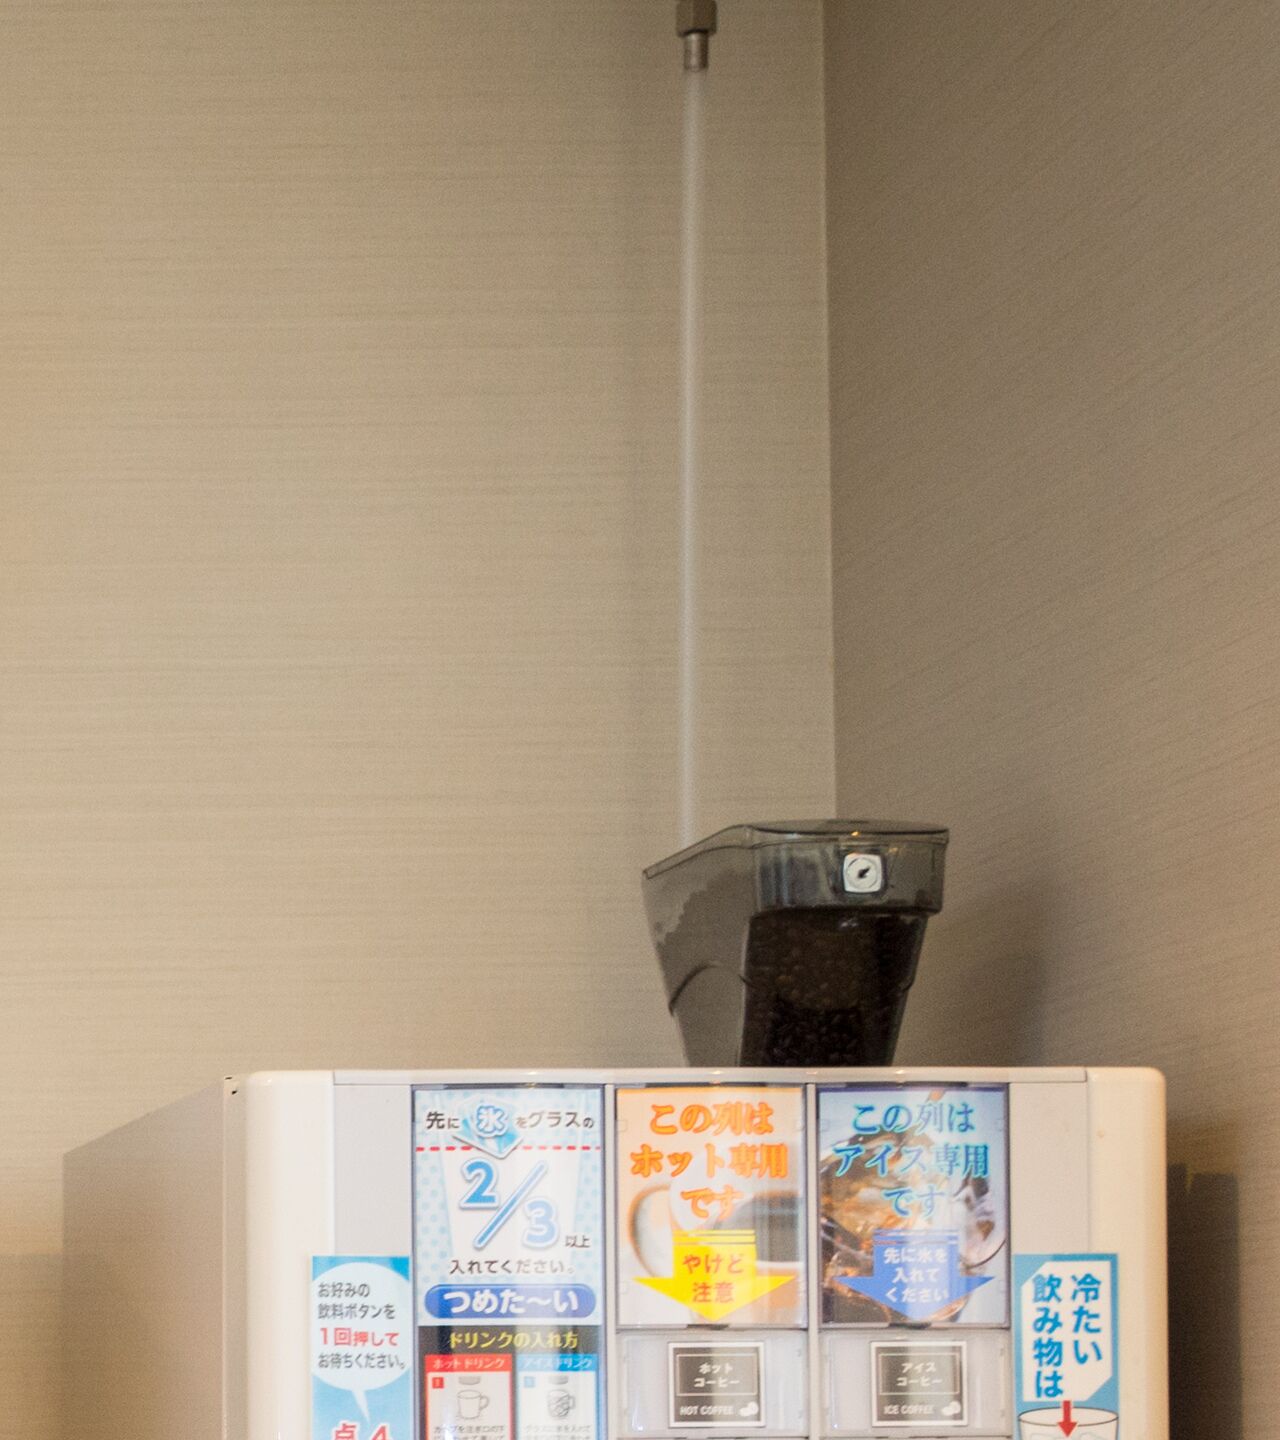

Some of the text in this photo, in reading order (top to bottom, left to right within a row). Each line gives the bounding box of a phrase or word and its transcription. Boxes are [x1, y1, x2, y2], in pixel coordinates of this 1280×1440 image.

[650, 1102, 774, 1136] この列は
[852, 1102, 975, 1135] この列は
[630, 1143, 788, 1178] ホット専用
[832, 1144, 990, 1178] アイス専用
[462, 1160, 558, 1248] 2/3
[681, 1184, 744, 1220] です
[883, 1185, 946, 1218] です
[565, 1235, 590, 1248] 以上
[450, 1259, 575, 1275] 入れてください。
[683, 1253, 744, 1274] やけど
[892, 1267, 940, 1283] 入れて
[318, 1282, 370, 1298] お好みの
[692, 1282, 735, 1303] 注意
[885, 1288, 950, 1302] ください
[318, 1303, 396, 1320] 飲料ボタンを
[1071, 1273, 1103, 1364] 冷たい
[320, 1327, 399, 1346] 1回押して
[449, 1332, 578, 1349] ドリンクの入れ方
[1032, 1274, 1064, 1398] 飲み物は
[318, 1353, 406, 1370] お待ちください。
[699, 1362, 733, 1373] ホット
[901, 1362, 936, 1373] アイス
[694, 1377, 740, 1388] コーヒー
[897, 1377, 943, 1387] コーヒー
[680, 1405, 734, 1416] HOT COFFEE
[884, 1405, 934, 1415] ICE COFFEE
